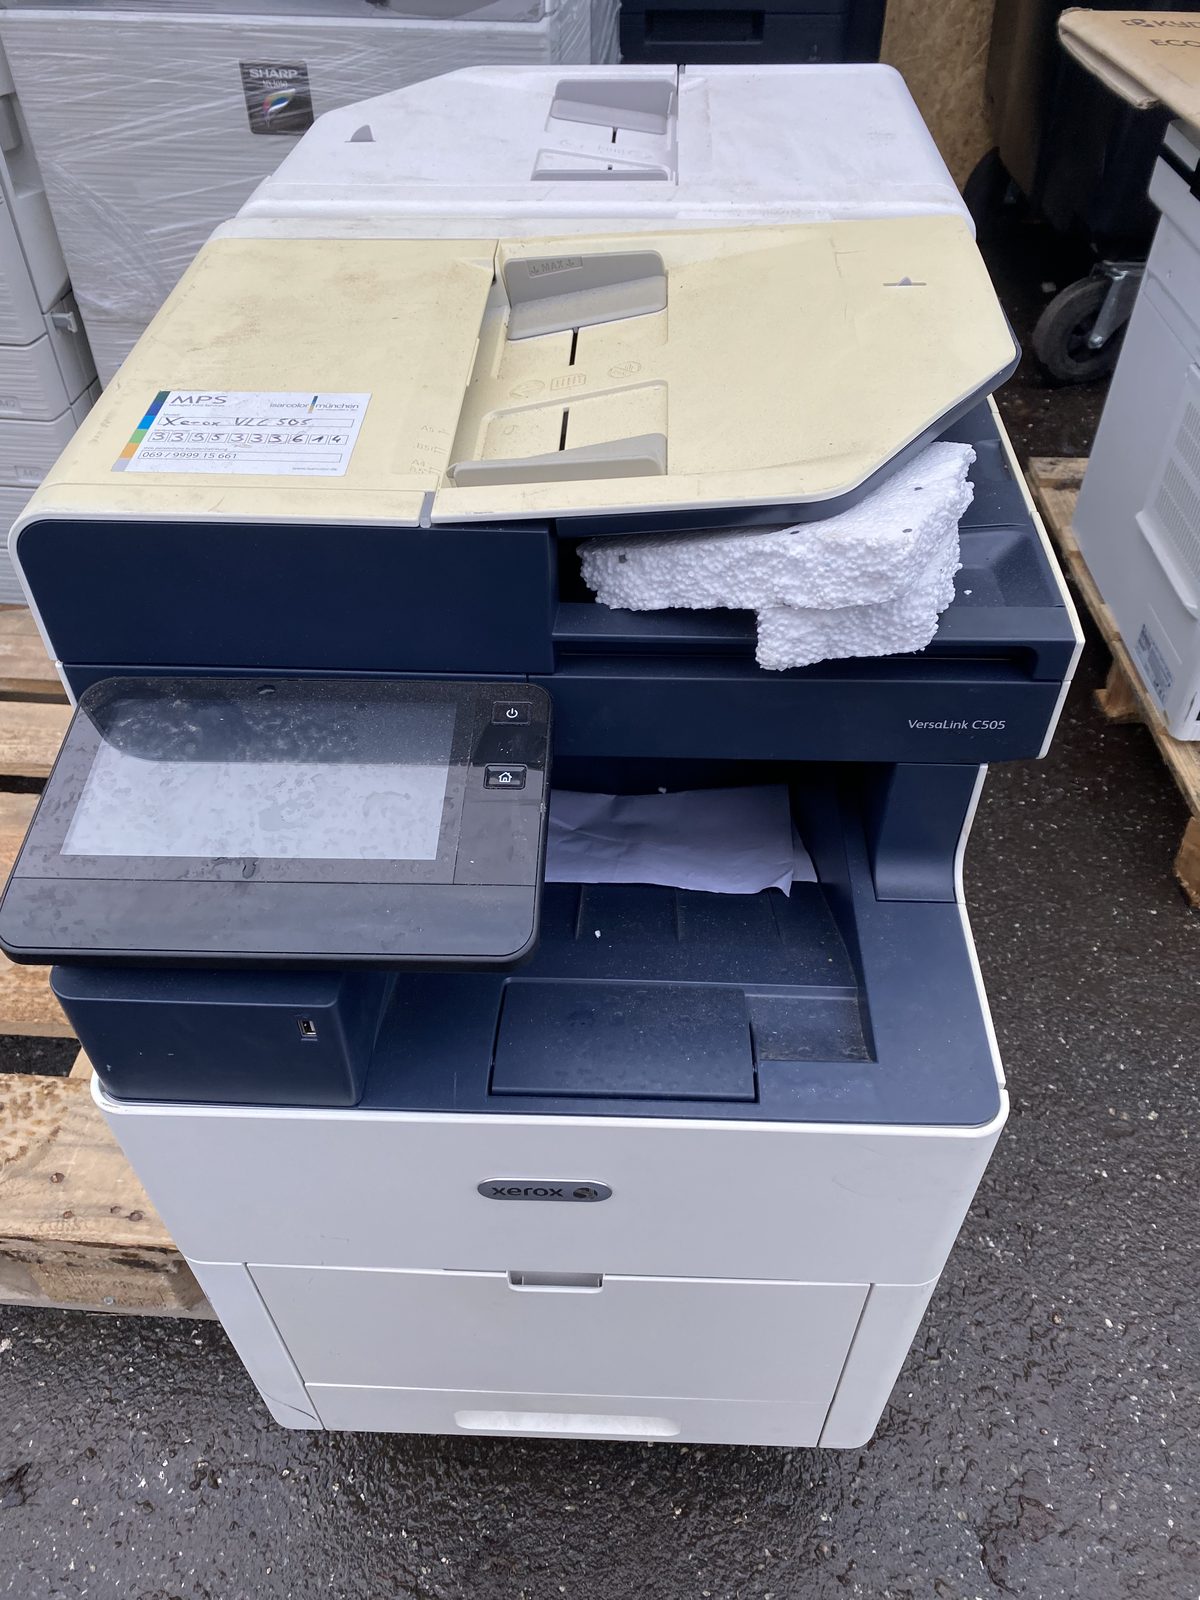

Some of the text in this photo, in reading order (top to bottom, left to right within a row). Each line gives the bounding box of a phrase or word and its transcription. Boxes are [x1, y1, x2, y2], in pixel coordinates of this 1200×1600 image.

[249, 68, 298, 79] SHARP
[171, 395, 228, 405] MPS
[142, 451, 163, 459] 069
[908, 719, 1006, 730] VersaLink C505
[491, 1186, 564, 1198] xerox
